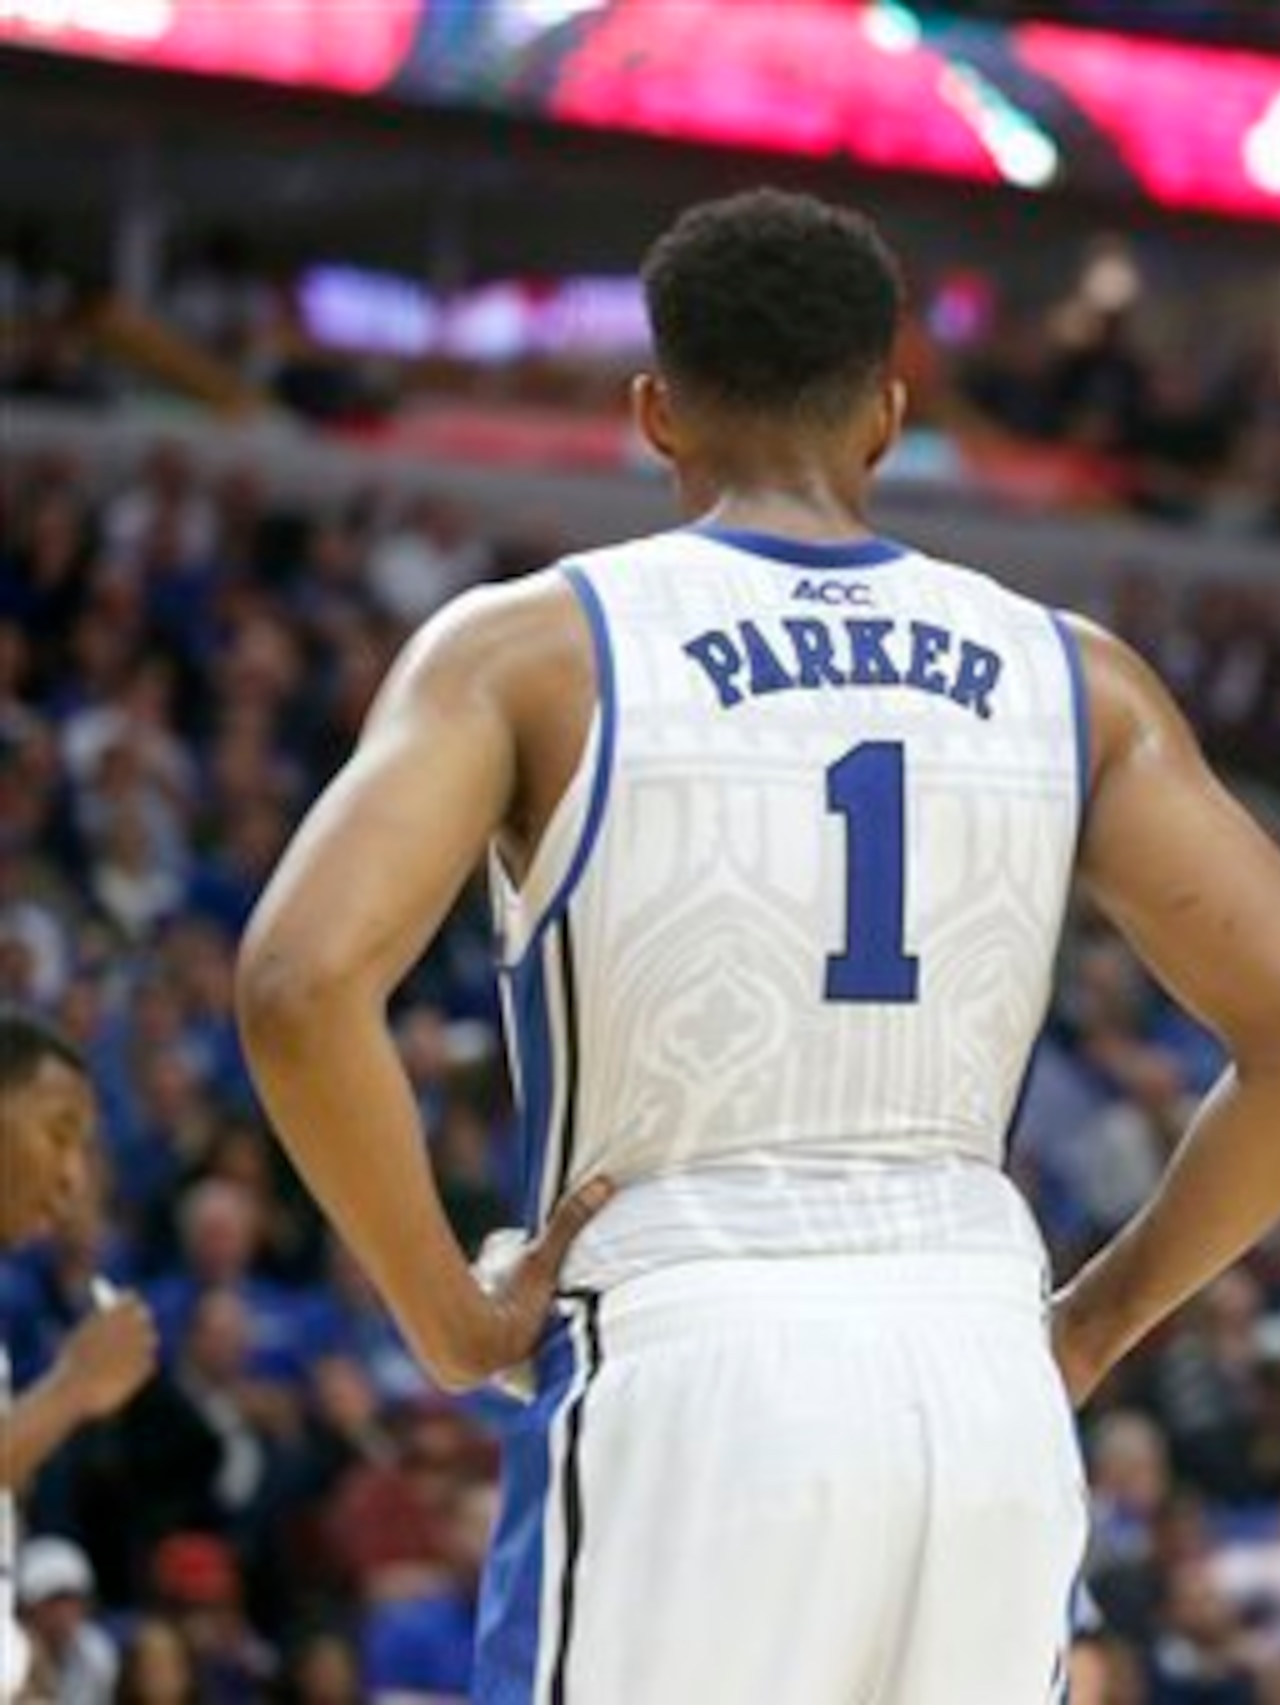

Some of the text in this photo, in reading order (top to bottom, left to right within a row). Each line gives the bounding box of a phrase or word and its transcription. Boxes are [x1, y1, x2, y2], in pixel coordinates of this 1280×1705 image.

[790, 580, 874, 606] ACC
[681, 616, 1005, 720] PARKER
[822, 739, 920, 1002] 1
